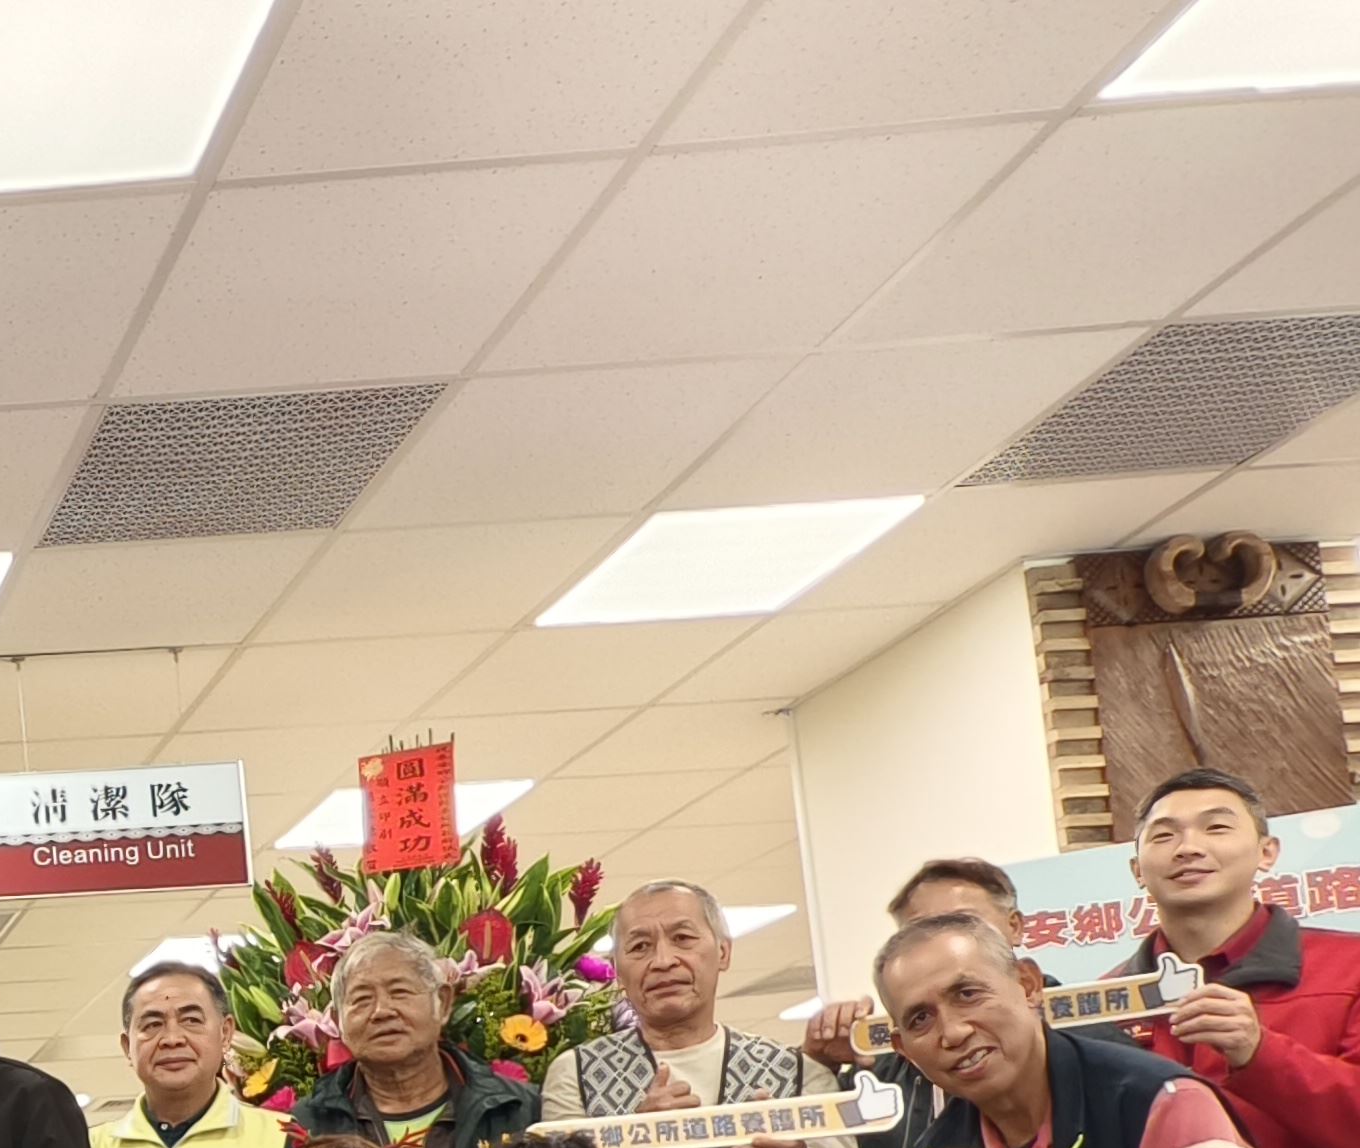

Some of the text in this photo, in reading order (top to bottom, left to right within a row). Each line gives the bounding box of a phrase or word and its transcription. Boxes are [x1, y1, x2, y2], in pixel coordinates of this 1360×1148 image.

[30, 781, 191, 826] 清潔隊
[396, 758, 431, 853] 圓滿成功
[32, 838, 196, 867] Cleaning Unit
